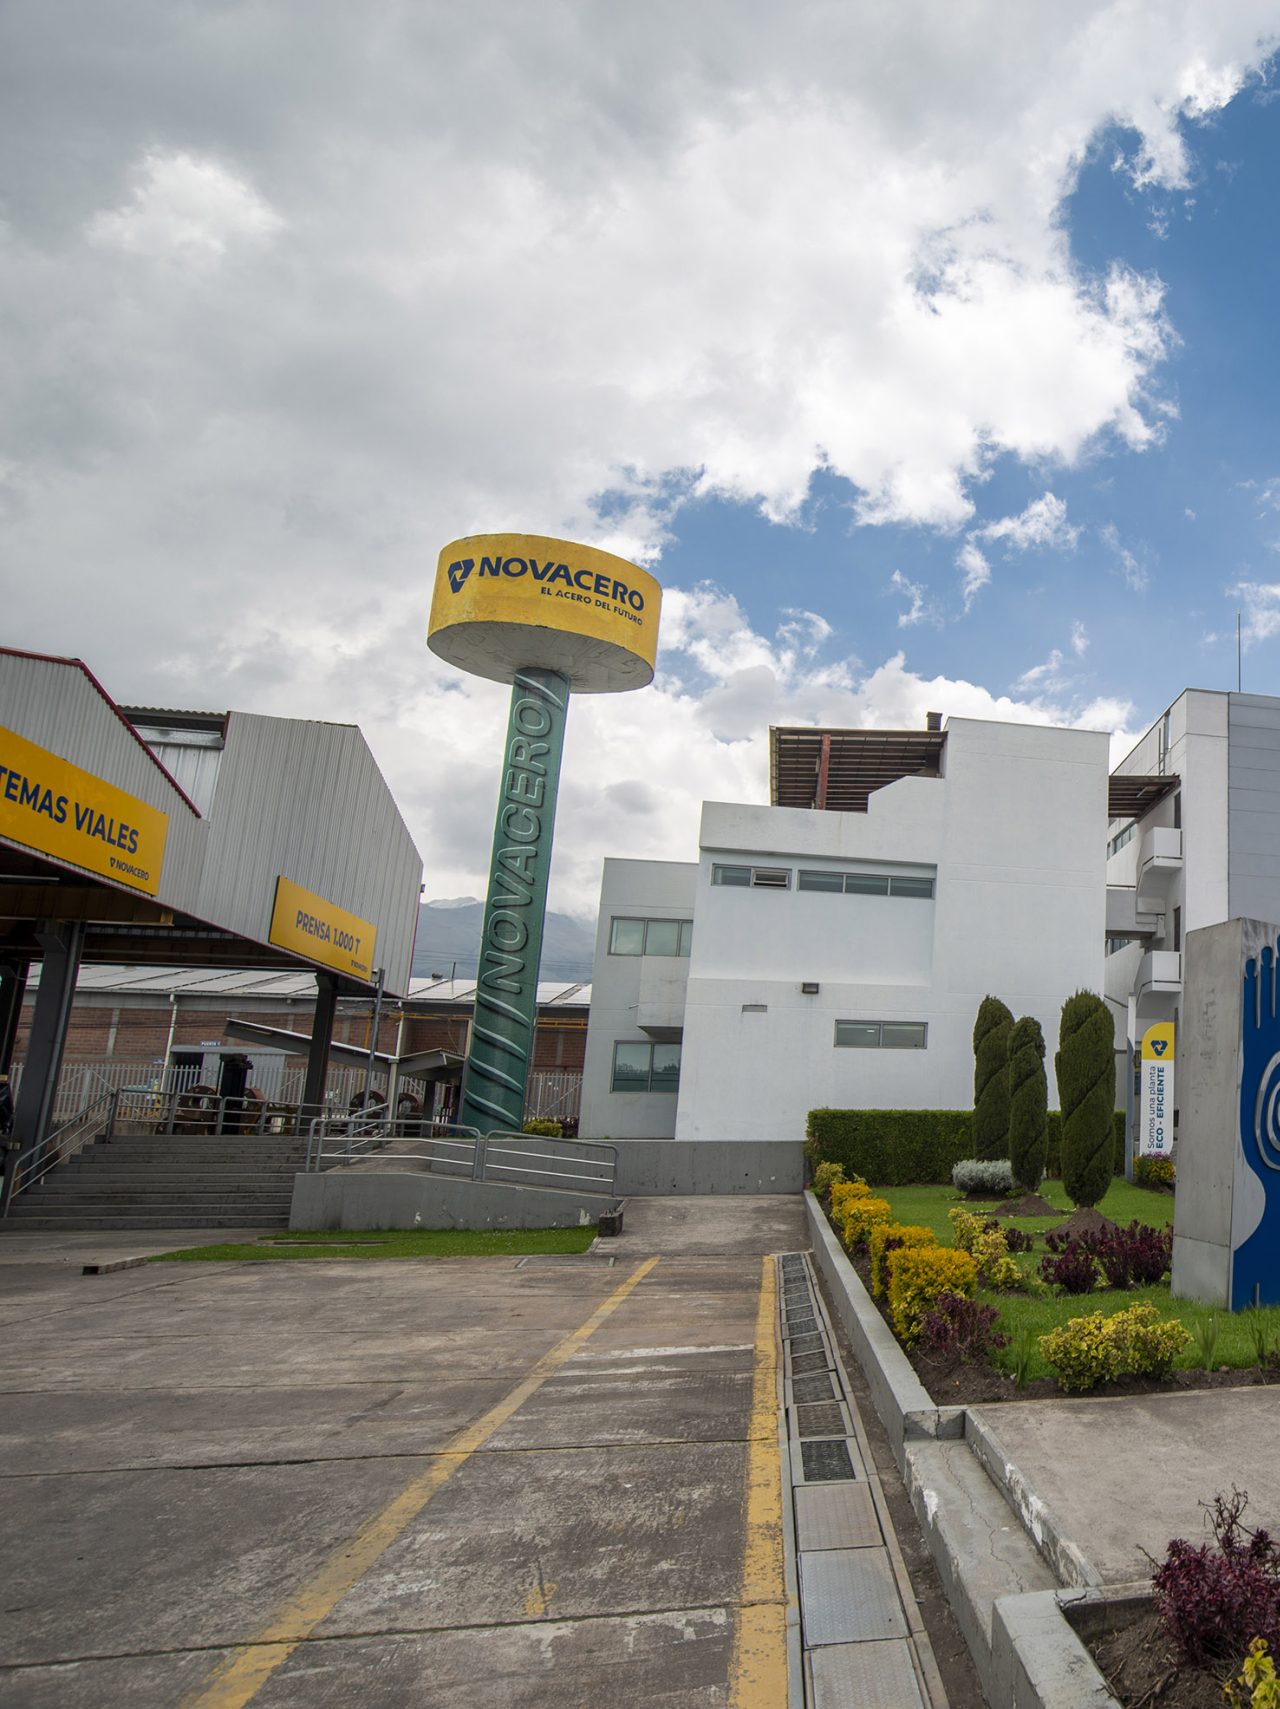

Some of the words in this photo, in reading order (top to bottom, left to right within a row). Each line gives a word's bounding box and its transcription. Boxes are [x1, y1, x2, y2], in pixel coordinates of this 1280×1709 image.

[479, 556, 645, 612] NOVACERO
[540, 586, 552, 596] EL
[555, 589, 592, 605] ACERO
[594, 599, 611, 612] DEL
[613, 606, 643, 626] FUTURO
[74, 802, 139, 854] VIALES
[480, 698, 553, 997] NOVACERO
[115, 859, 150, 881] NOVACERO
[296, 910, 331, 943] PRENSA
[355, 937, 361, 956] T
[1148, 1066, 1156, 1095] planta
[1157, 1066, 1165, 1119] EFICIENTE
[1147, 1117, 1156, 1149] Somos
[1156, 1128, 1164, 1149] ECO
